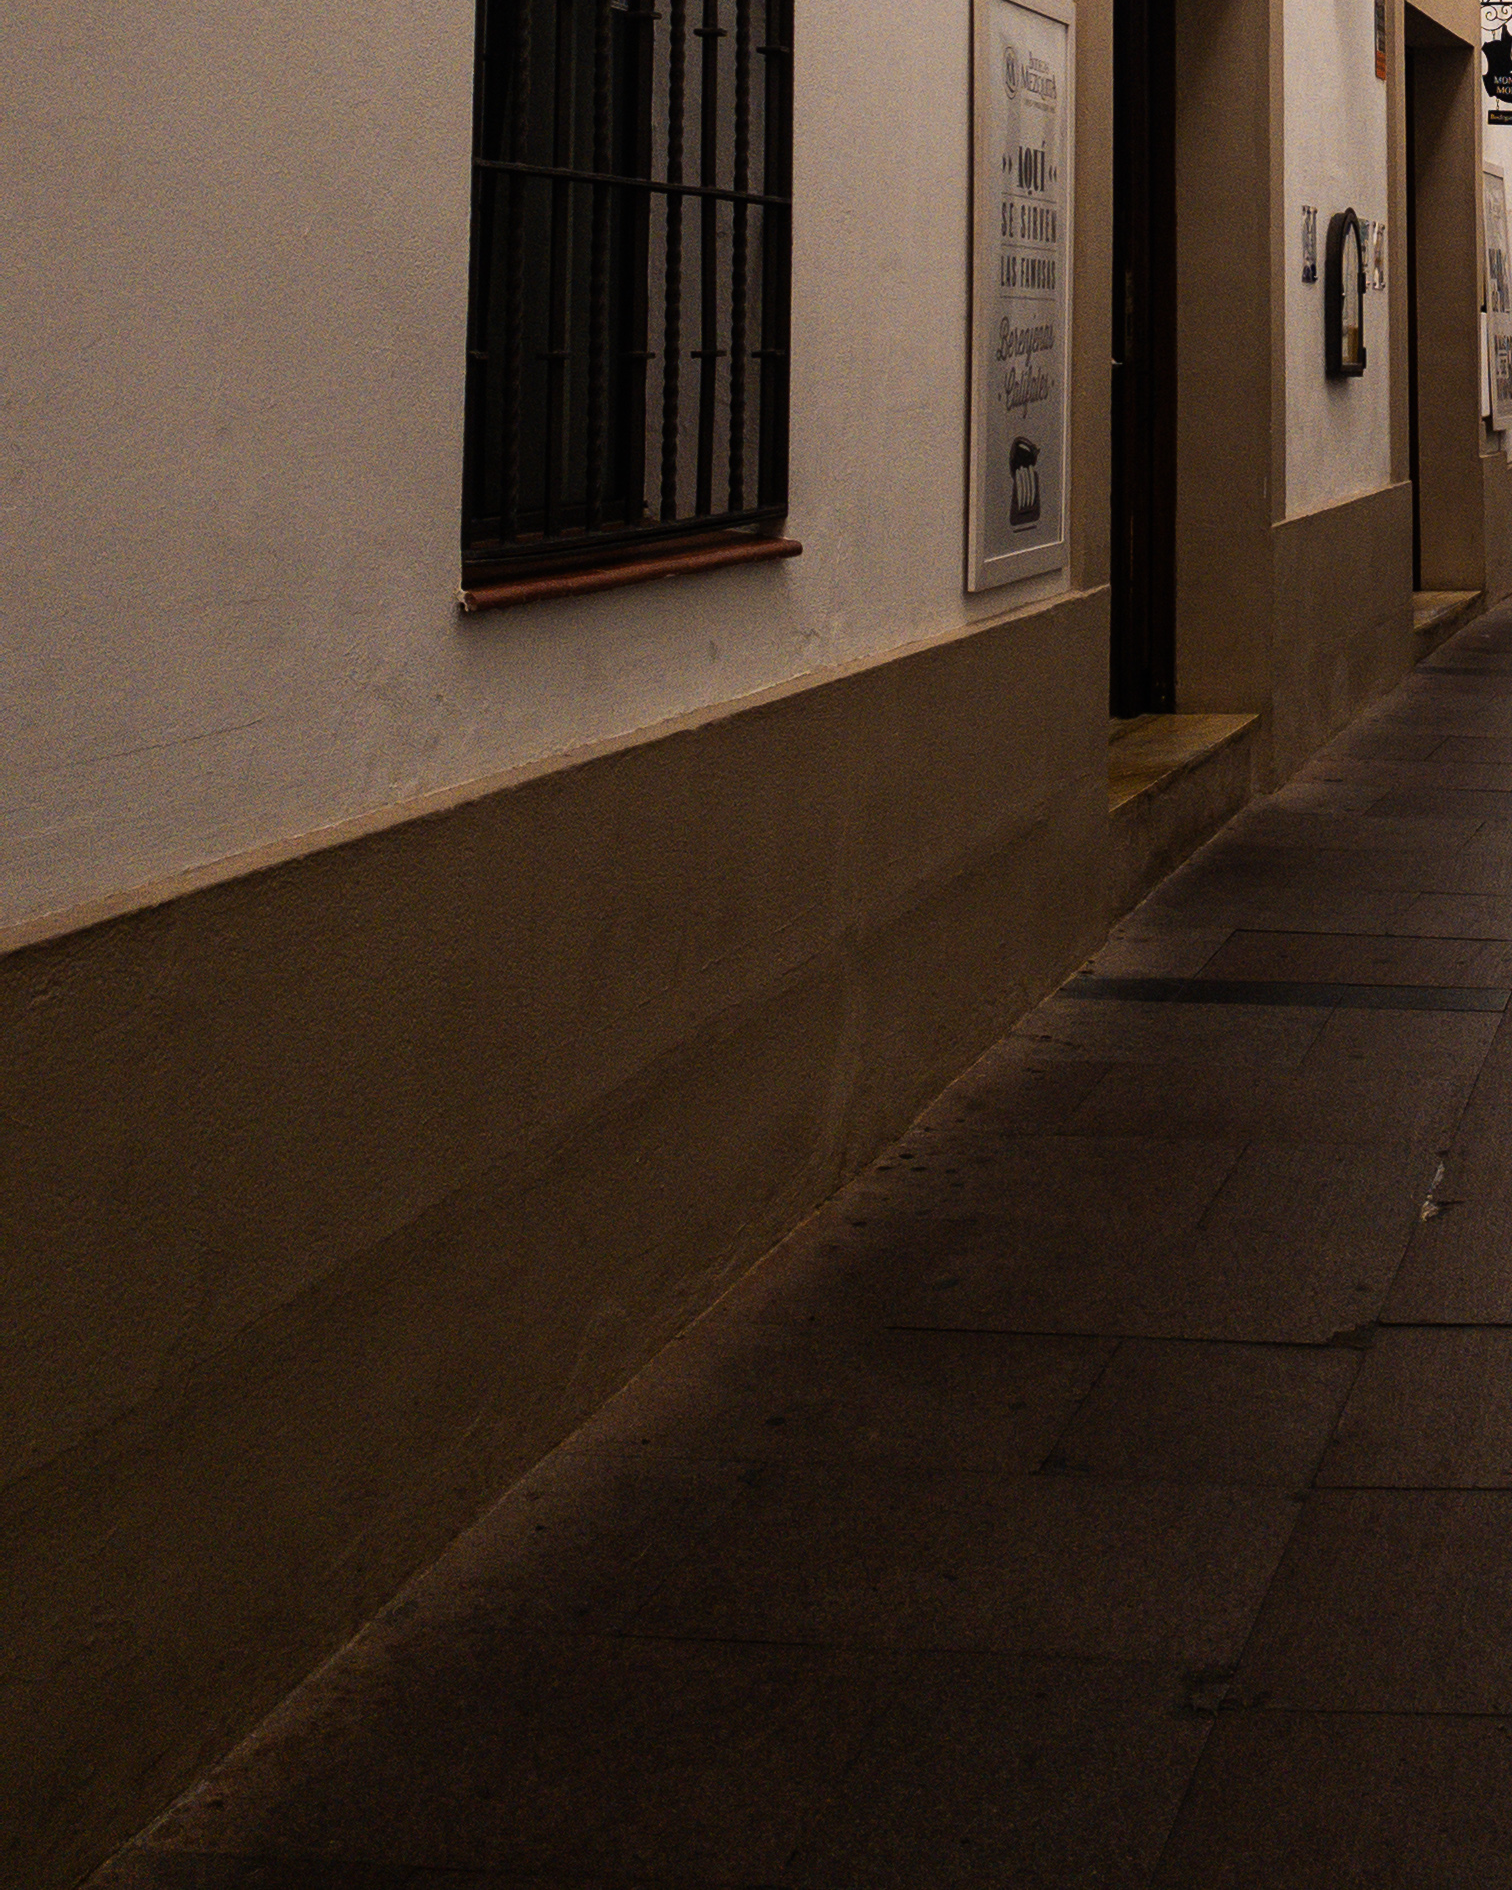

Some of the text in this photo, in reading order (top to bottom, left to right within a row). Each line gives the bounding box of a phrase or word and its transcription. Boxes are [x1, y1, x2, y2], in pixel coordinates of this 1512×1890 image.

[1002, 202, 1056, 243] SE SIRVEN
[1001, 255, 1056, 290] LAS FAMOSAS
